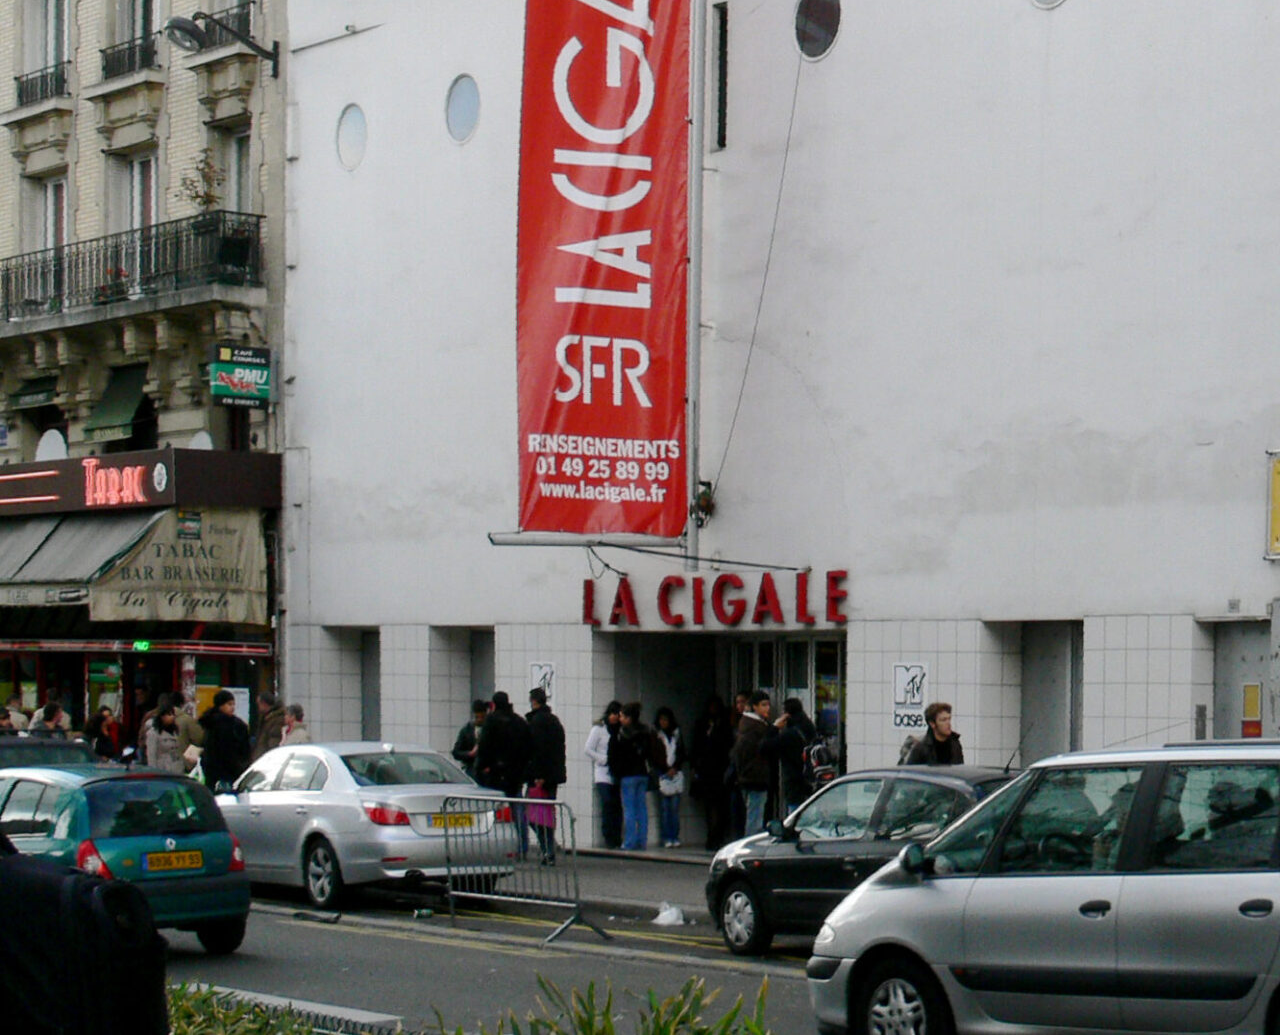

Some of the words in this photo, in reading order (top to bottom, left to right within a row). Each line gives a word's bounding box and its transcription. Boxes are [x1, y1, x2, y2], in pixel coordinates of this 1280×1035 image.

[555, 230, 652, 308] LA
[234, 368, 268, 384] PMU
[554, 334, 652, 407] SFR
[528, 434, 680, 459] RENSEIGNEMENTS
[535, 456, 556, 475] 01
[562, 457, 583, 477] 49
[588, 459, 611, 478] 25
[615, 460, 640, 480] 89
[644, 462, 670, 481] 99
[539, 480, 667, 503] www.lacigale.fr
[152, 543, 222, 560] TABAC
[120, 566, 154, 582] BAR
[163, 566, 243, 584] BRASSERIE
[119, 590, 145, 608] La
[582, 574, 639, 626] LA
[657, 570, 849, 626] CIGALE
[894, 665, 926, 708] MTV
